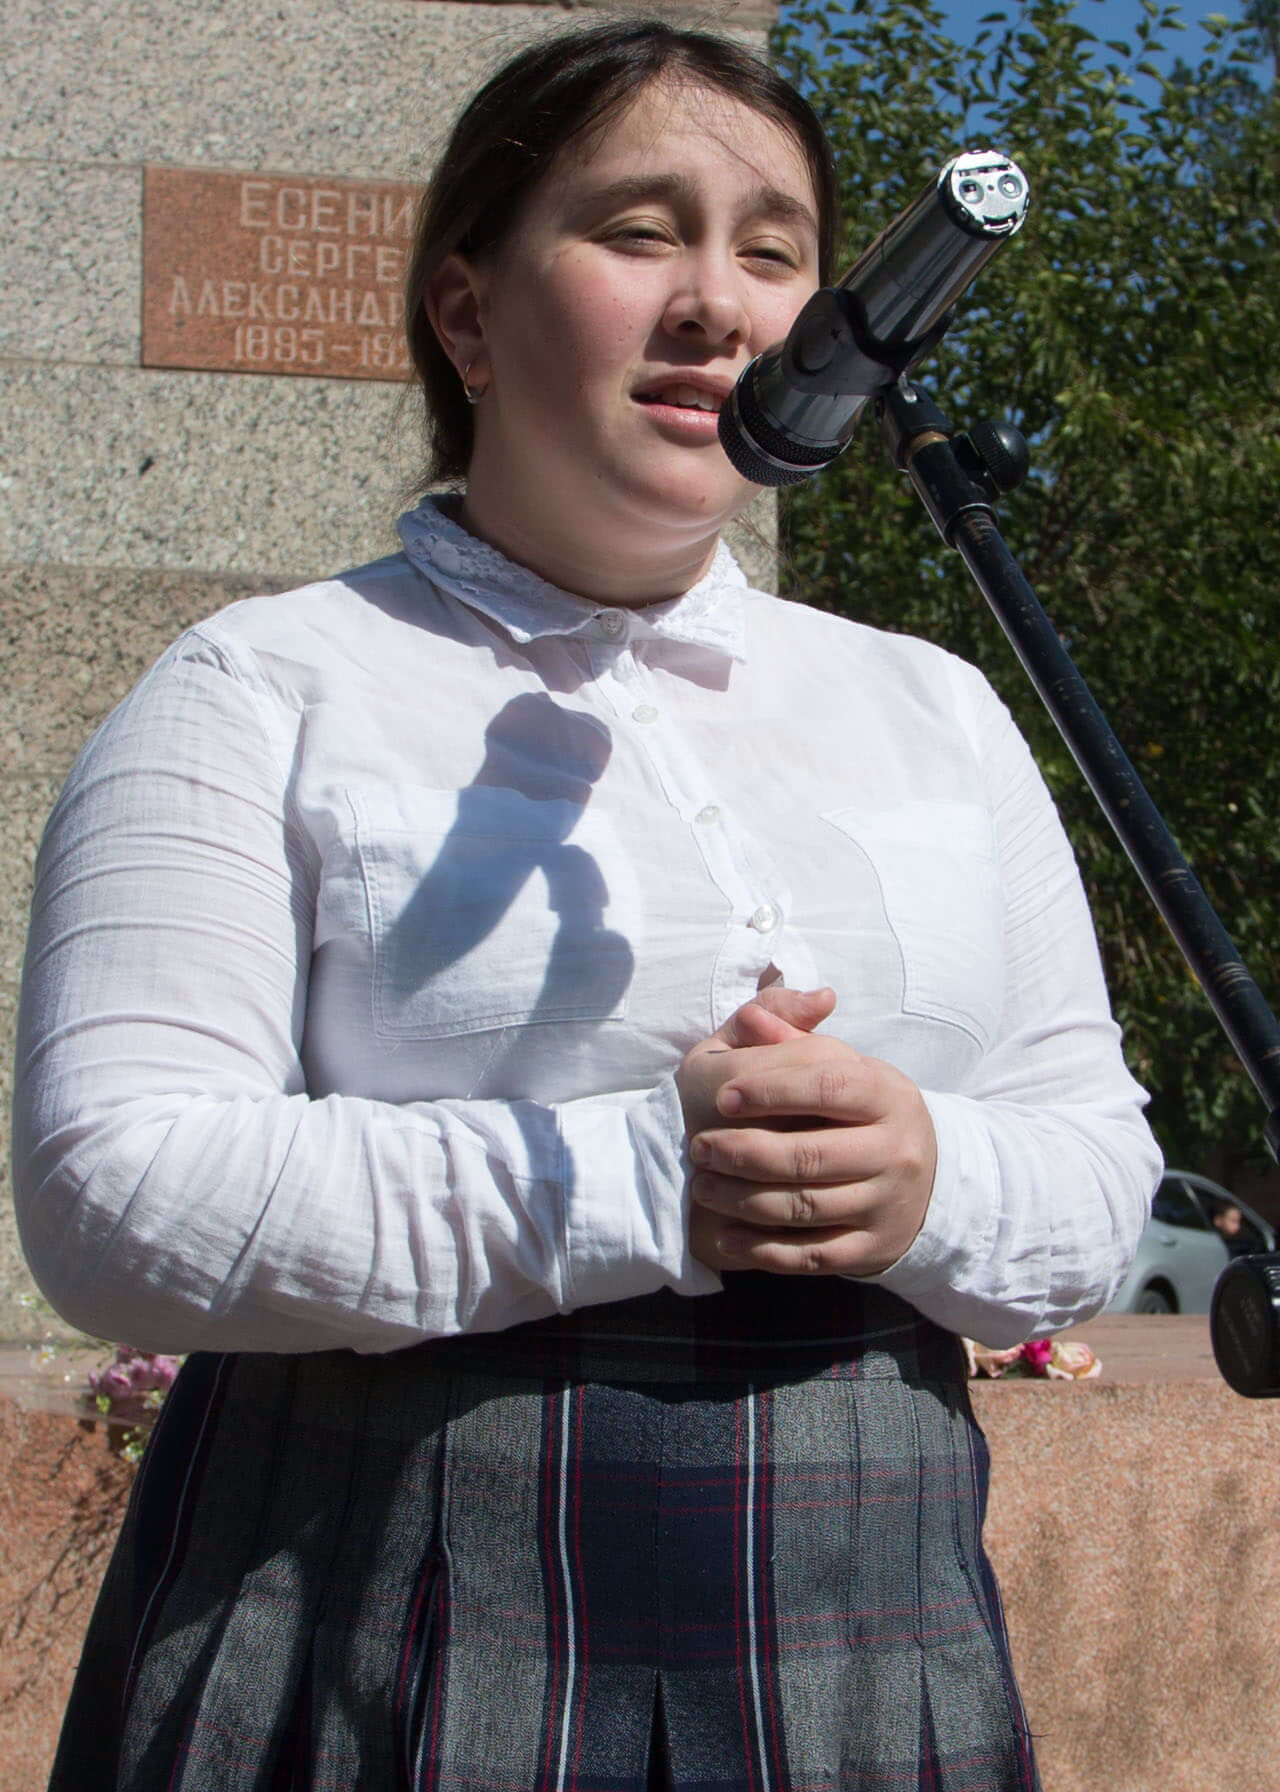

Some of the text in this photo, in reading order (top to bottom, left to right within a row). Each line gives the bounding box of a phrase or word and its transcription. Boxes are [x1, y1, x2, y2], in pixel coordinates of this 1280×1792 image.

[240, 180, 415, 238] ЕСЕНИ
[259, 234, 405, 284] СЕРГЕ
[168, 275, 407, 327] АЛЕКСАНДР
[234, 324, 413, 370] 1895-192
